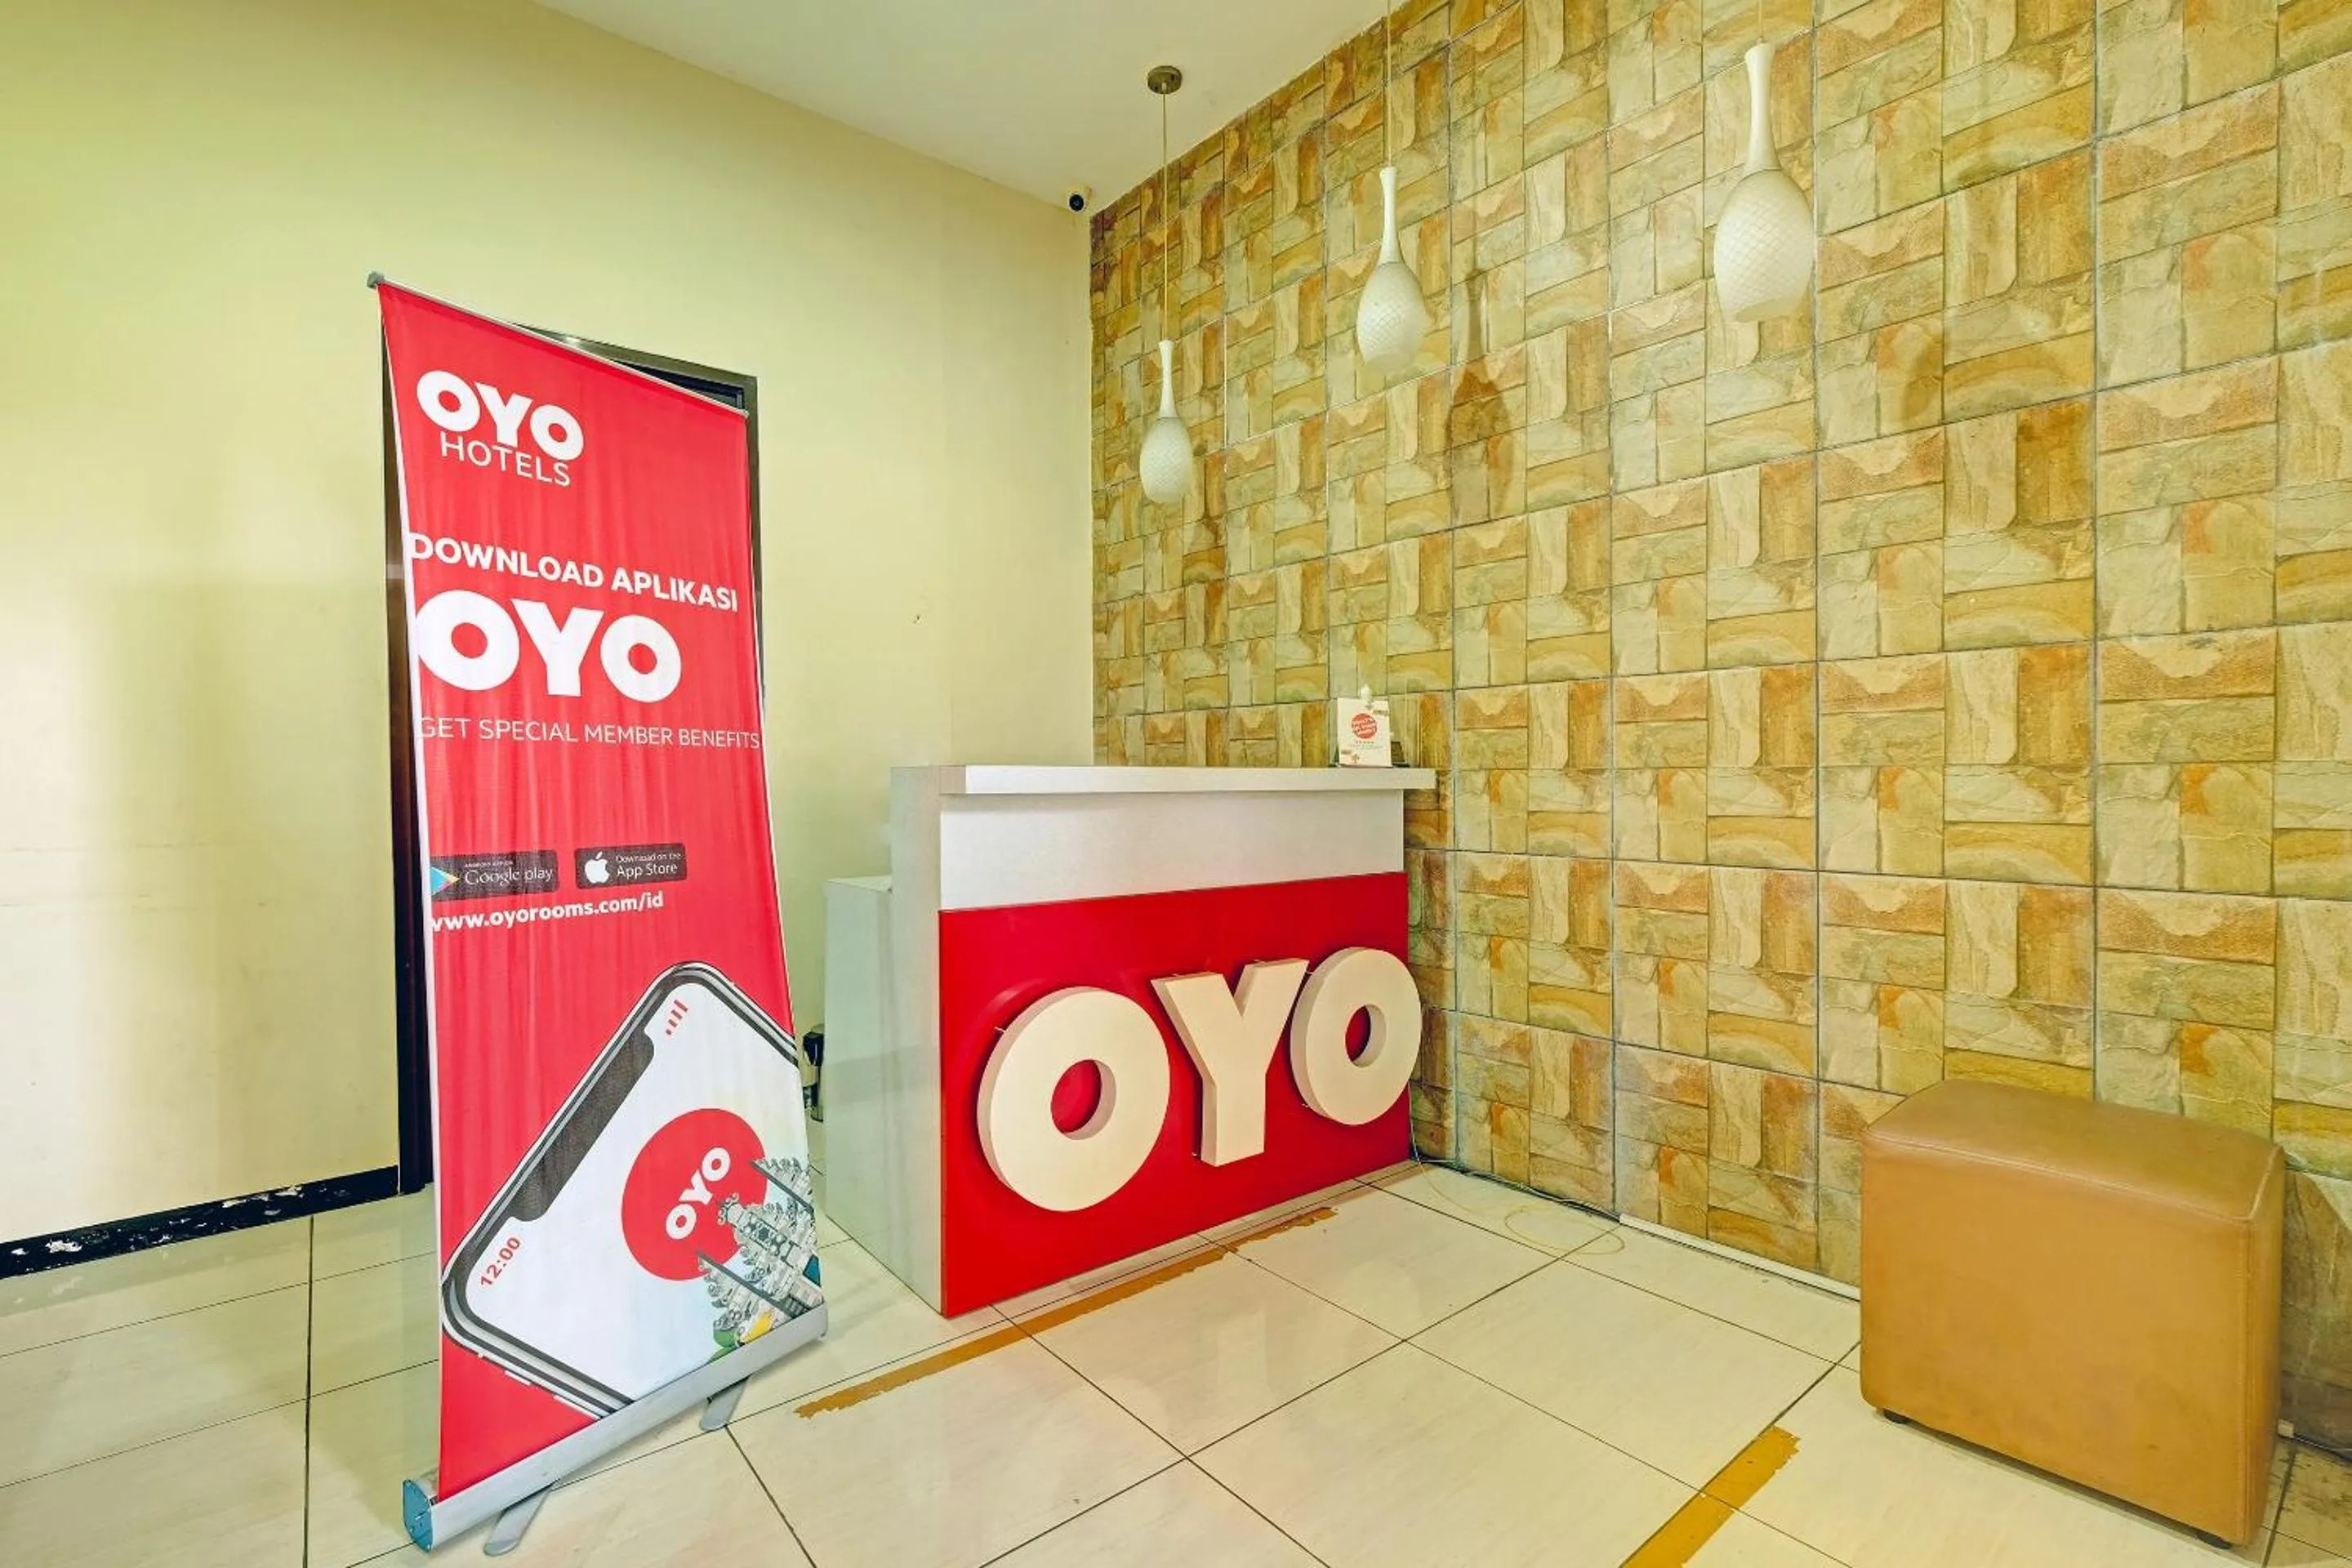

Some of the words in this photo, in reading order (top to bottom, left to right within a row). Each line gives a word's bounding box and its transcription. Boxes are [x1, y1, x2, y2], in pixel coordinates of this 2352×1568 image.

[416, 371, 584, 461] OYO
[439, 431, 571, 487] HOTELS
[410, 533, 604, 588] DOWNLOAD
[611, 567, 738, 612] APLIKASI
[415, 590, 682, 702] OYO
[421, 717, 471, 738] GET
[479, 719, 578, 742] SPECIAL
[584, 724, 674, 745] MEMBER
[679, 728, 760, 749] BENEFITS
[465, 867, 520, 887] Google
[525, 867, 554, 883] play
[617, 865, 644, 880] App
[646, 862, 679, 876] Store
[977, 947, 1423, 1212] OYO
[666, 1147, 731, 1240] OYO
[480, 1237, 520, 1285] 12:00
